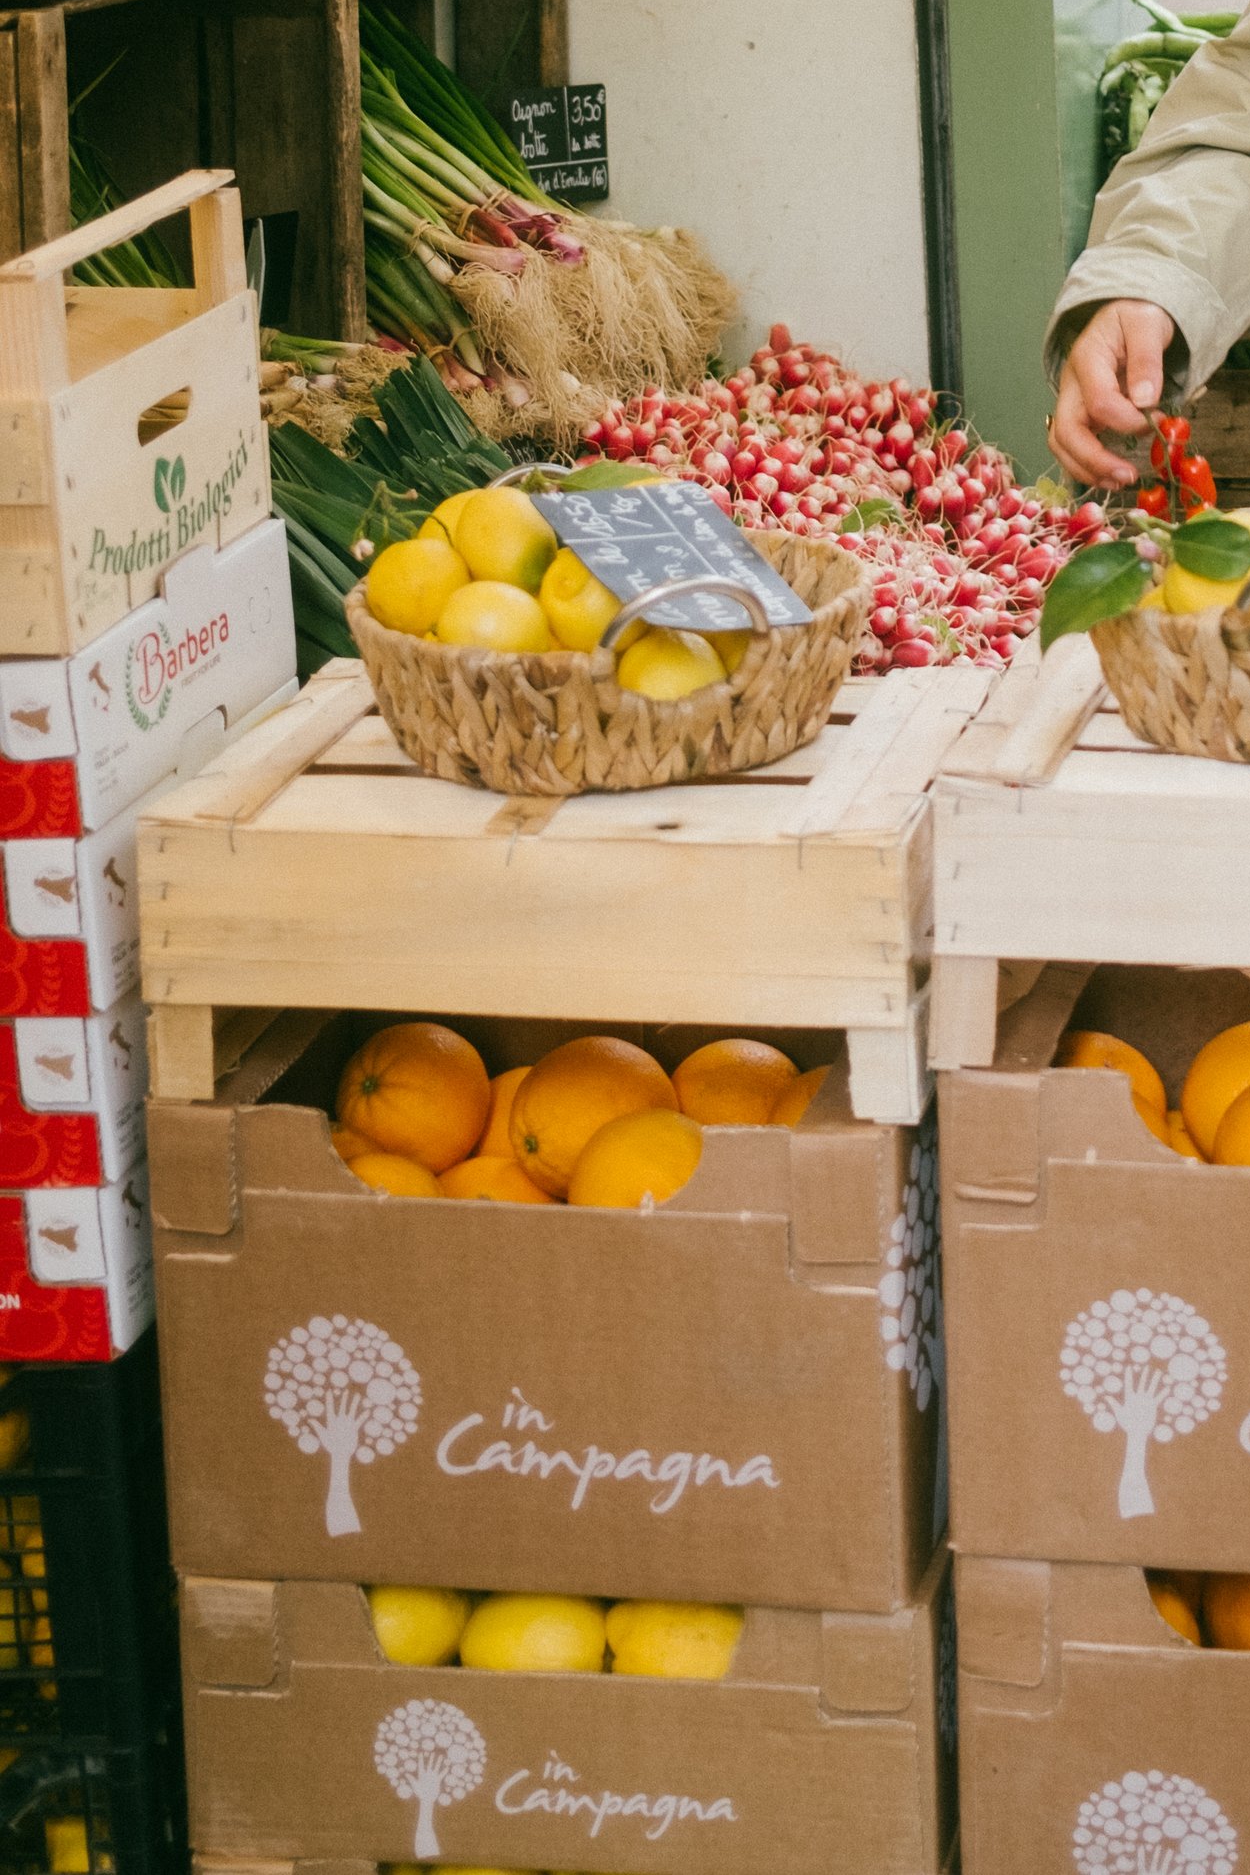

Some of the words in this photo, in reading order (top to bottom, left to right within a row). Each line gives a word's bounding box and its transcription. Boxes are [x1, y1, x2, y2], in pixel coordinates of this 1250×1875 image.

[88, 516, 171, 575] Prodotti
[177, 429, 249, 550] Biologici
[136, 612, 229, 705] Barbera
[502, 1387, 554, 1432] in
[436, 1412, 781, 1514] Campagna
[495, 1769, 738, 1840] Campagna
[542, 1751, 580, 1784] in
